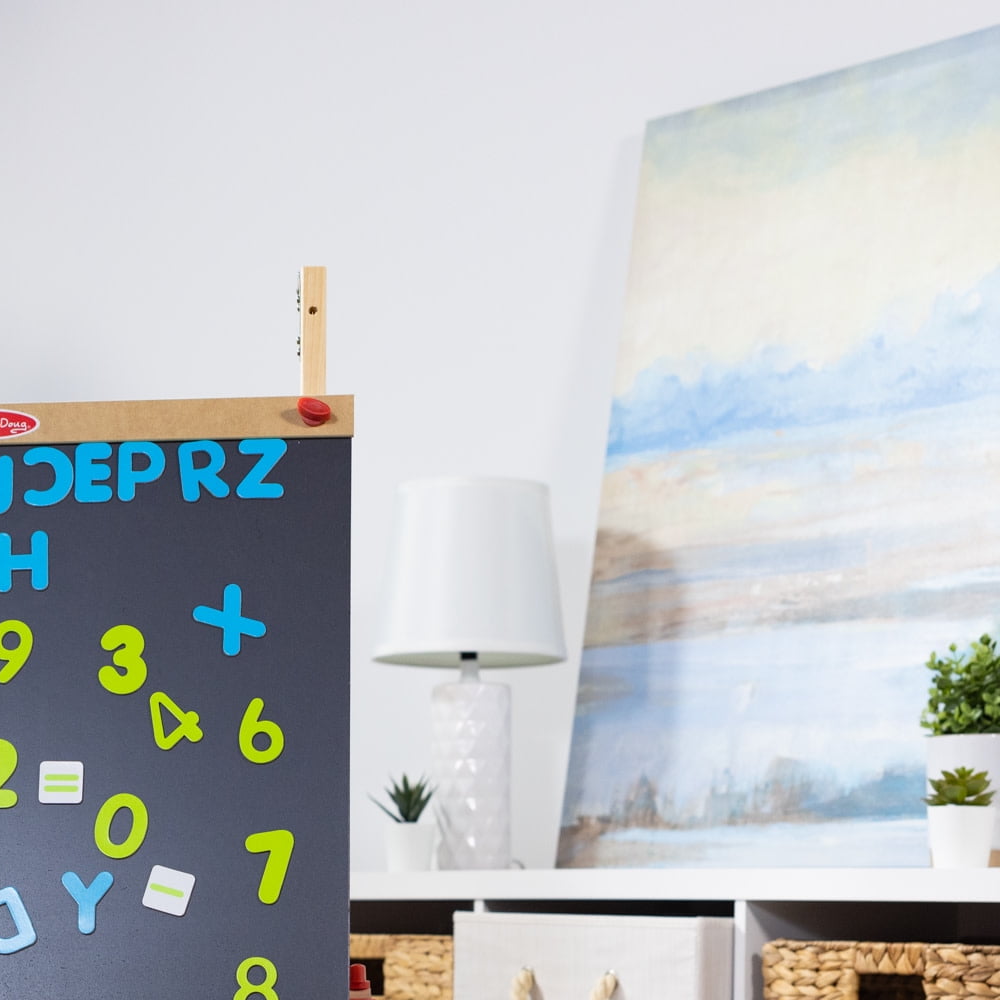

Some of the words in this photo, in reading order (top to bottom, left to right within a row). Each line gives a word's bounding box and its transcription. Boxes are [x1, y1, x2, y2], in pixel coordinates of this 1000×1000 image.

[0, 417, 28, 434] Doug
[98, 624, 148, 695] 3
[149, 691, 204, 751] 4
[238, 697, 285, 764] 6
[244, 829, 295, 905] 7
[60, 870, 115, 935] Y
